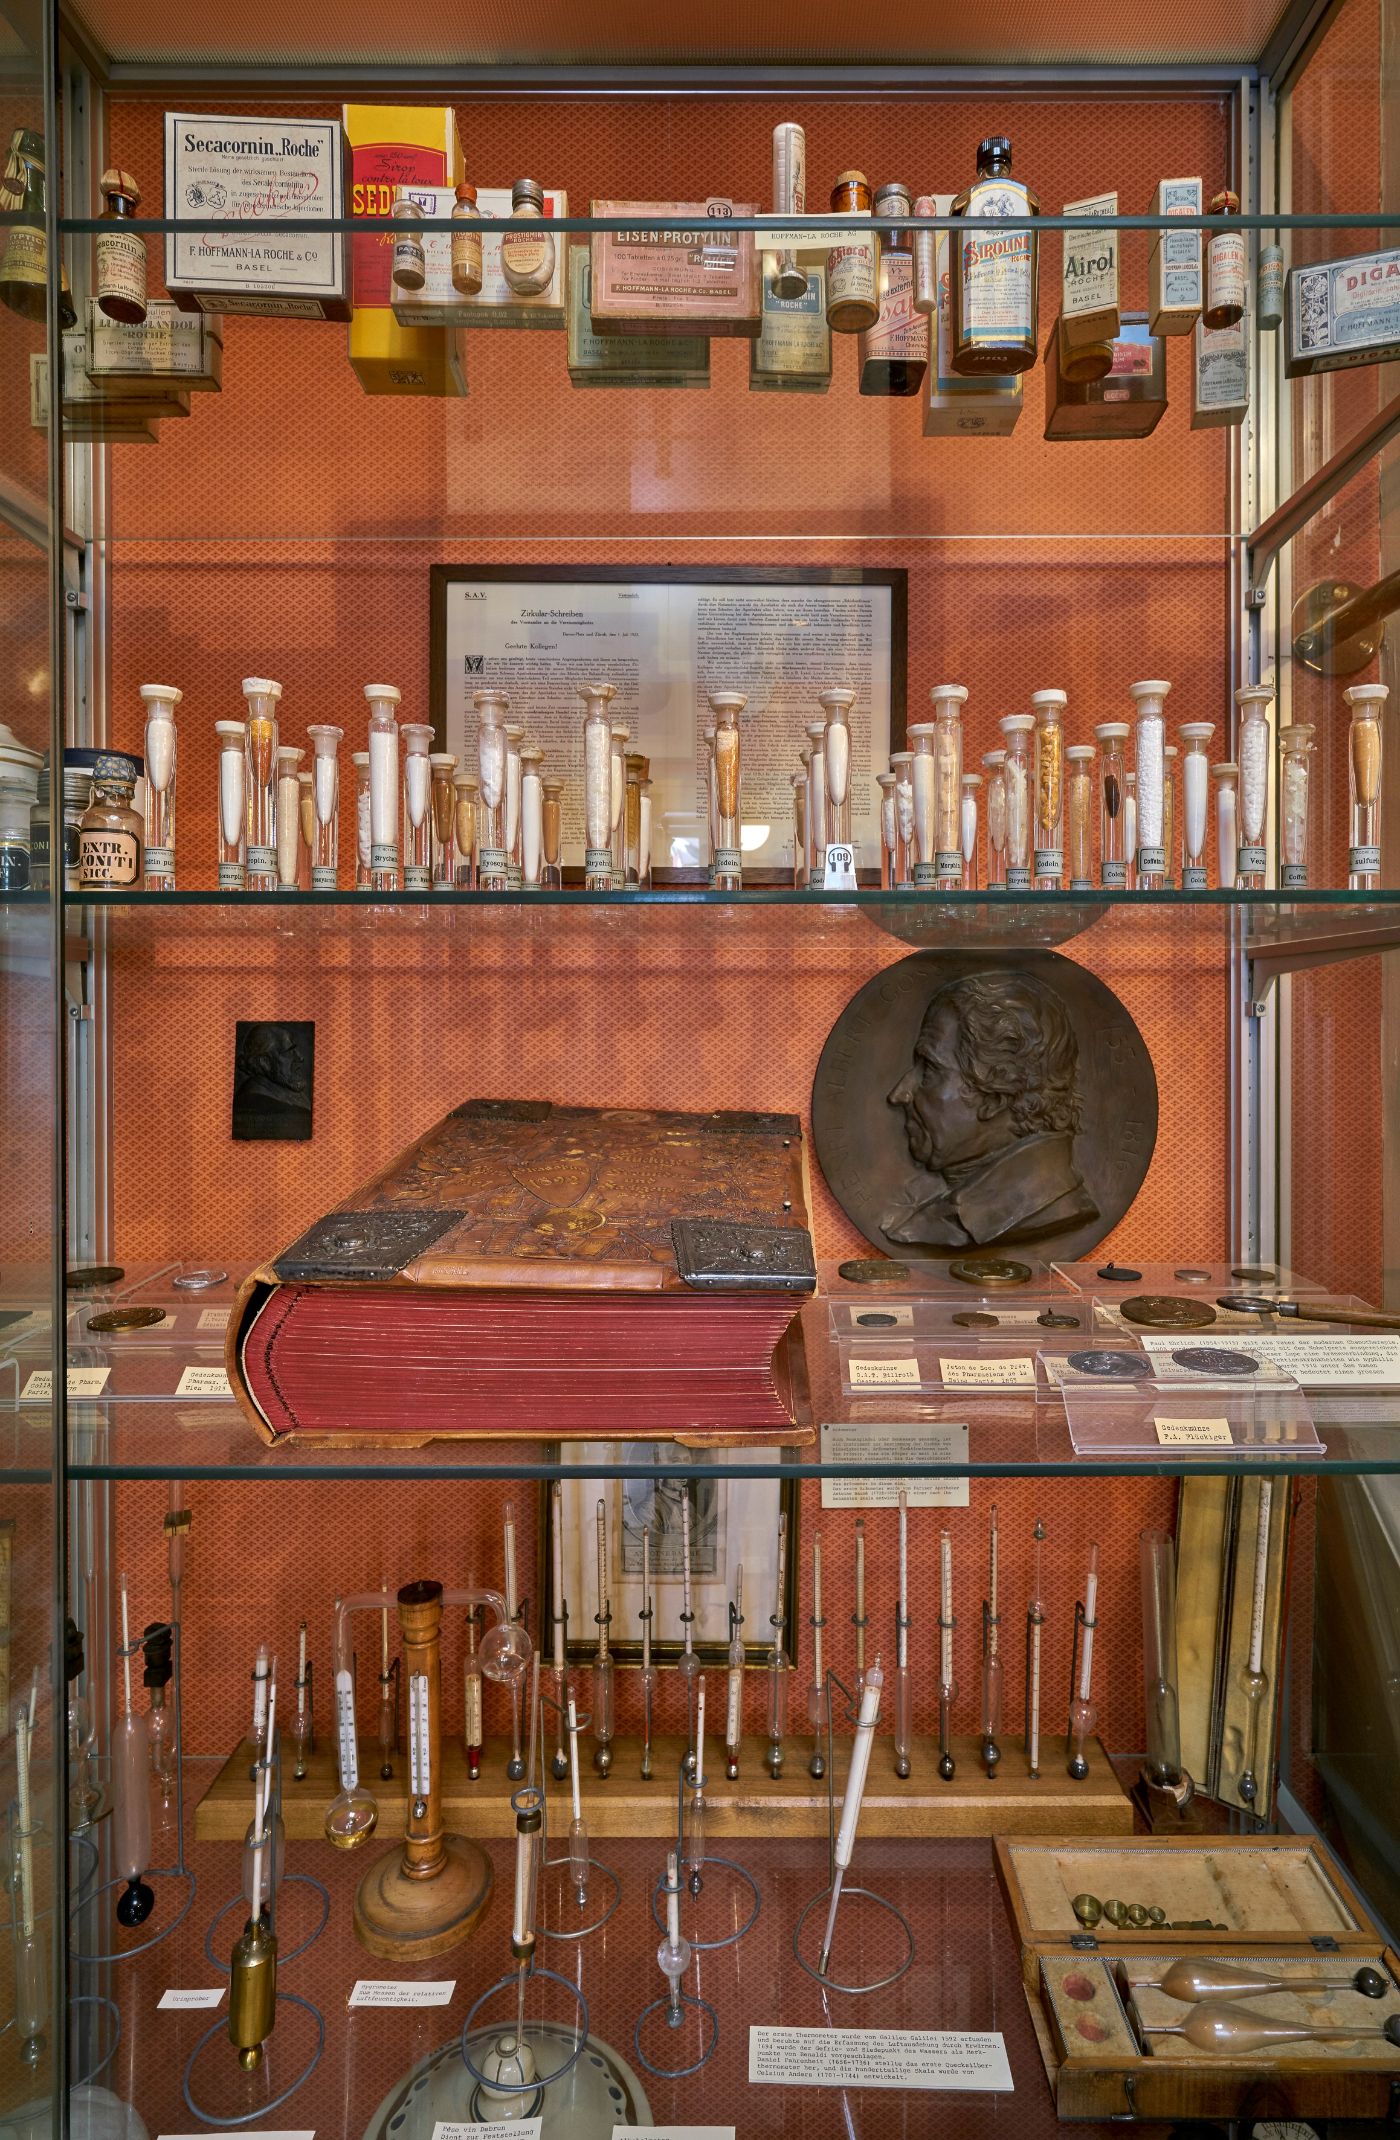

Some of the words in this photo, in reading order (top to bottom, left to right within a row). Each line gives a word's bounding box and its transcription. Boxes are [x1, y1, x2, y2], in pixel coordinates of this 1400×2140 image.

[185, 134, 274, 155] Secacornin
[375, 159, 415, 173] Sirop
[361, 173, 395, 184] contre
[398, 173, 408, 184] la
[413, 174, 433, 185] toux
[710, 207, 729, 216] 113
[190, 246, 196, 256] F.
[199, 246, 261, 260] HOFFMANN-LA
[264, 249, 294, 261] ROCHE
[236, 263, 272, 272] BASEL
[1065, 247, 1115, 279] Airol
[1072, 293, 1102, 304] BASEL
[520, 610, 584, 619] Zirkular-Schreiben
[530, 642, 558, 651] Kollegen!
[83, 842, 128, 854] EXTR.
[831, 853, 849, 862] 109
[83, 868, 113, 879] SICC.
[826, 1014, 873, 1105] ALBERT
[483, 2129, 535, 2140] Feststellung
